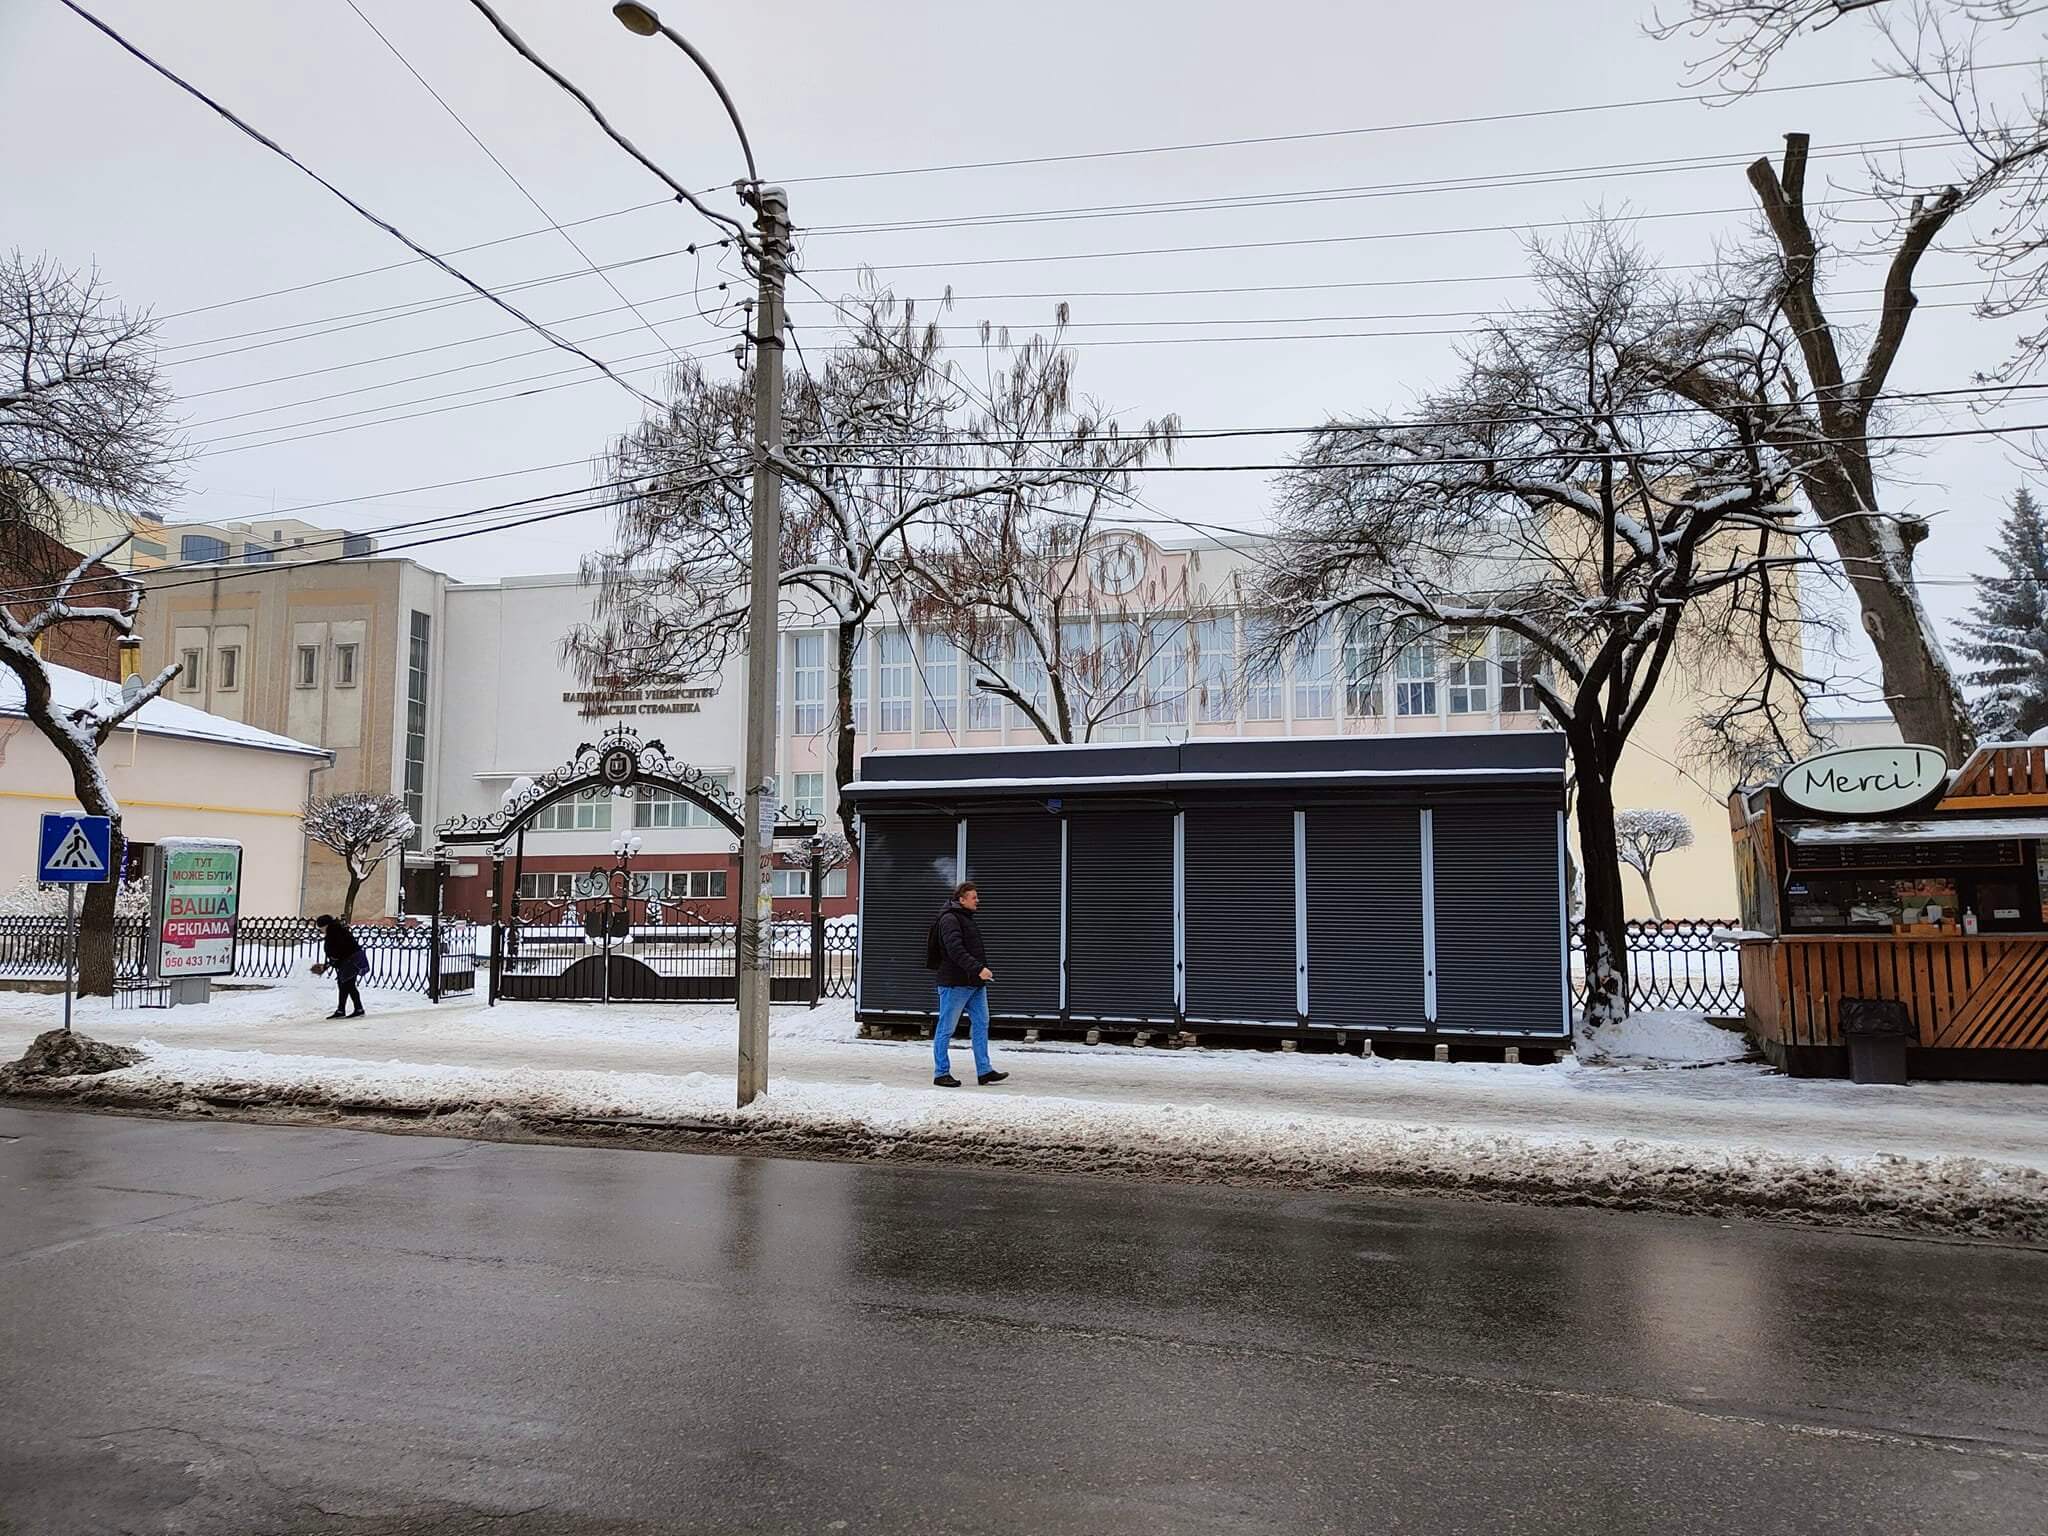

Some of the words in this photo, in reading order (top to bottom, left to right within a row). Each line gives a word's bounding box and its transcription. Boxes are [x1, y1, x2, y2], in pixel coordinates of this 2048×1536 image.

[638, 703, 701, 715] СТЕФАНИКА
[1805, 751, 1922, 794] Merci!
[194, 857, 213, 868] ТУТ
[172, 870, 204, 881] МОЖЕ
[207, 870, 232, 881] БУТИ
[170, 897, 230, 916] ВАША
[167, 921, 231, 936] РЕКЛАМА
[165, 957, 183, 968] 050
[185, 956, 203, 967] 433
[206, 955, 217, 966] 71
[219, 954, 231, 965] 41
